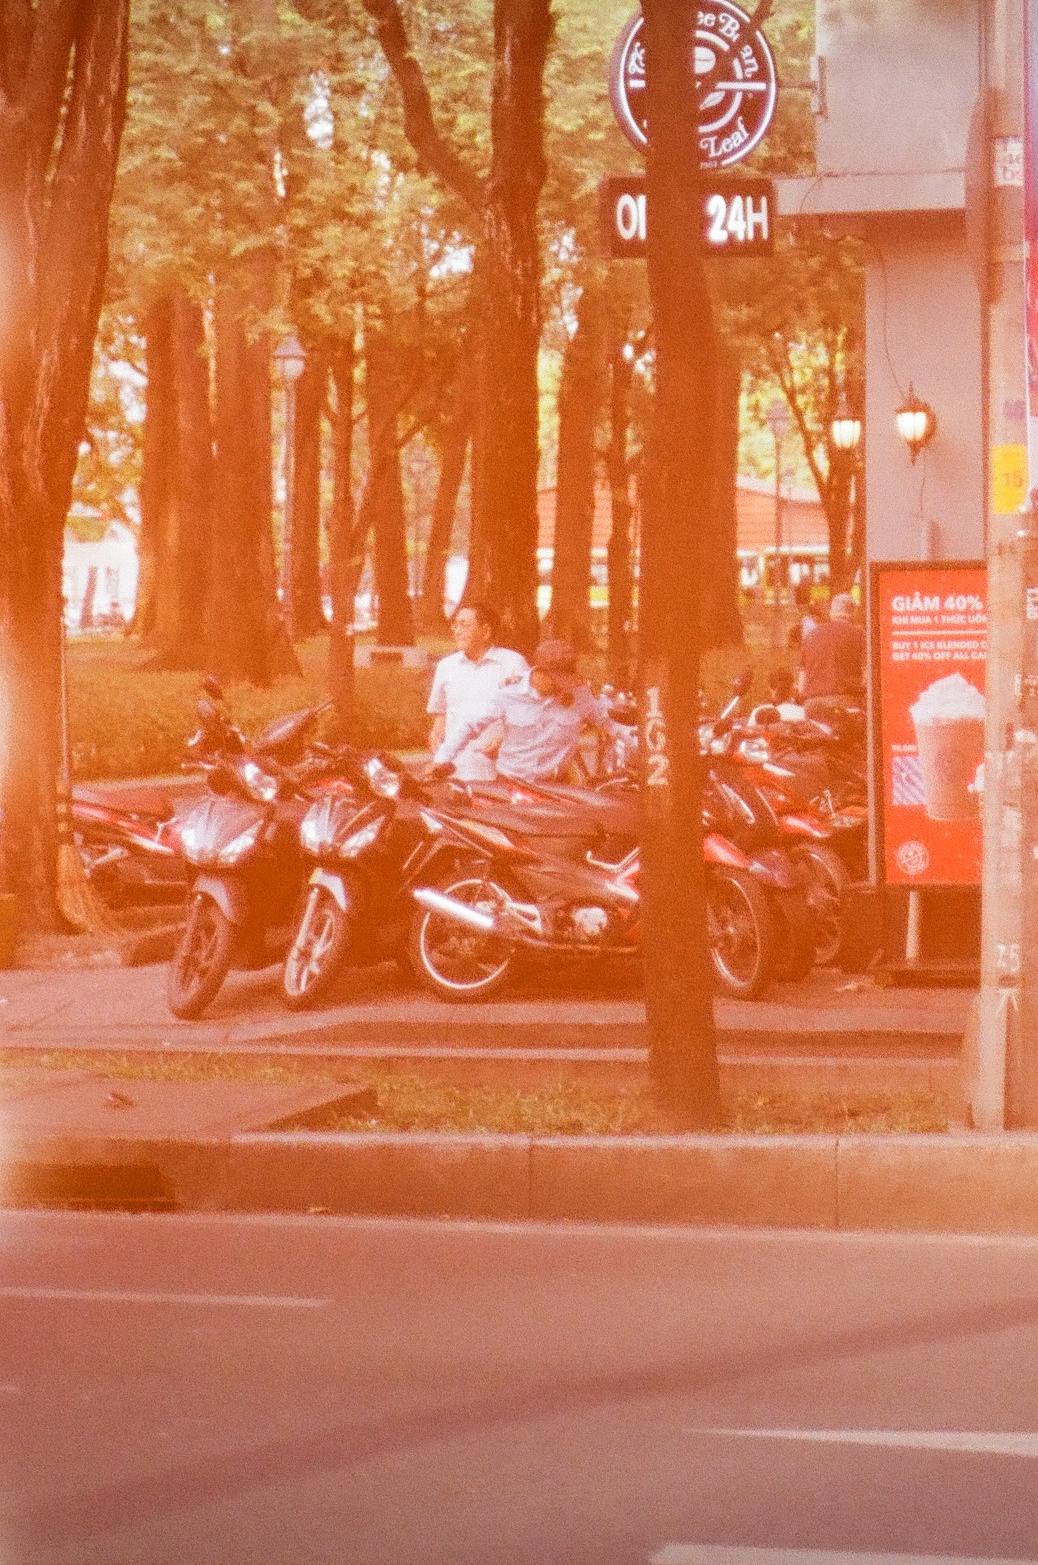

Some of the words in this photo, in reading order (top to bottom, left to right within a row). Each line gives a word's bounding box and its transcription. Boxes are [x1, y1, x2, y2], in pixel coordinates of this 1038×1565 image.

[718, 12, 759, 78] Ban
[706, 194, 768, 243] 24H
[892, 591, 940, 611] GIẢM
[944, 595, 983, 611] 40%
[911, 616, 932, 624] MUA
[934, 651, 951, 660] OFF
[953, 651, 970, 659] ALL
